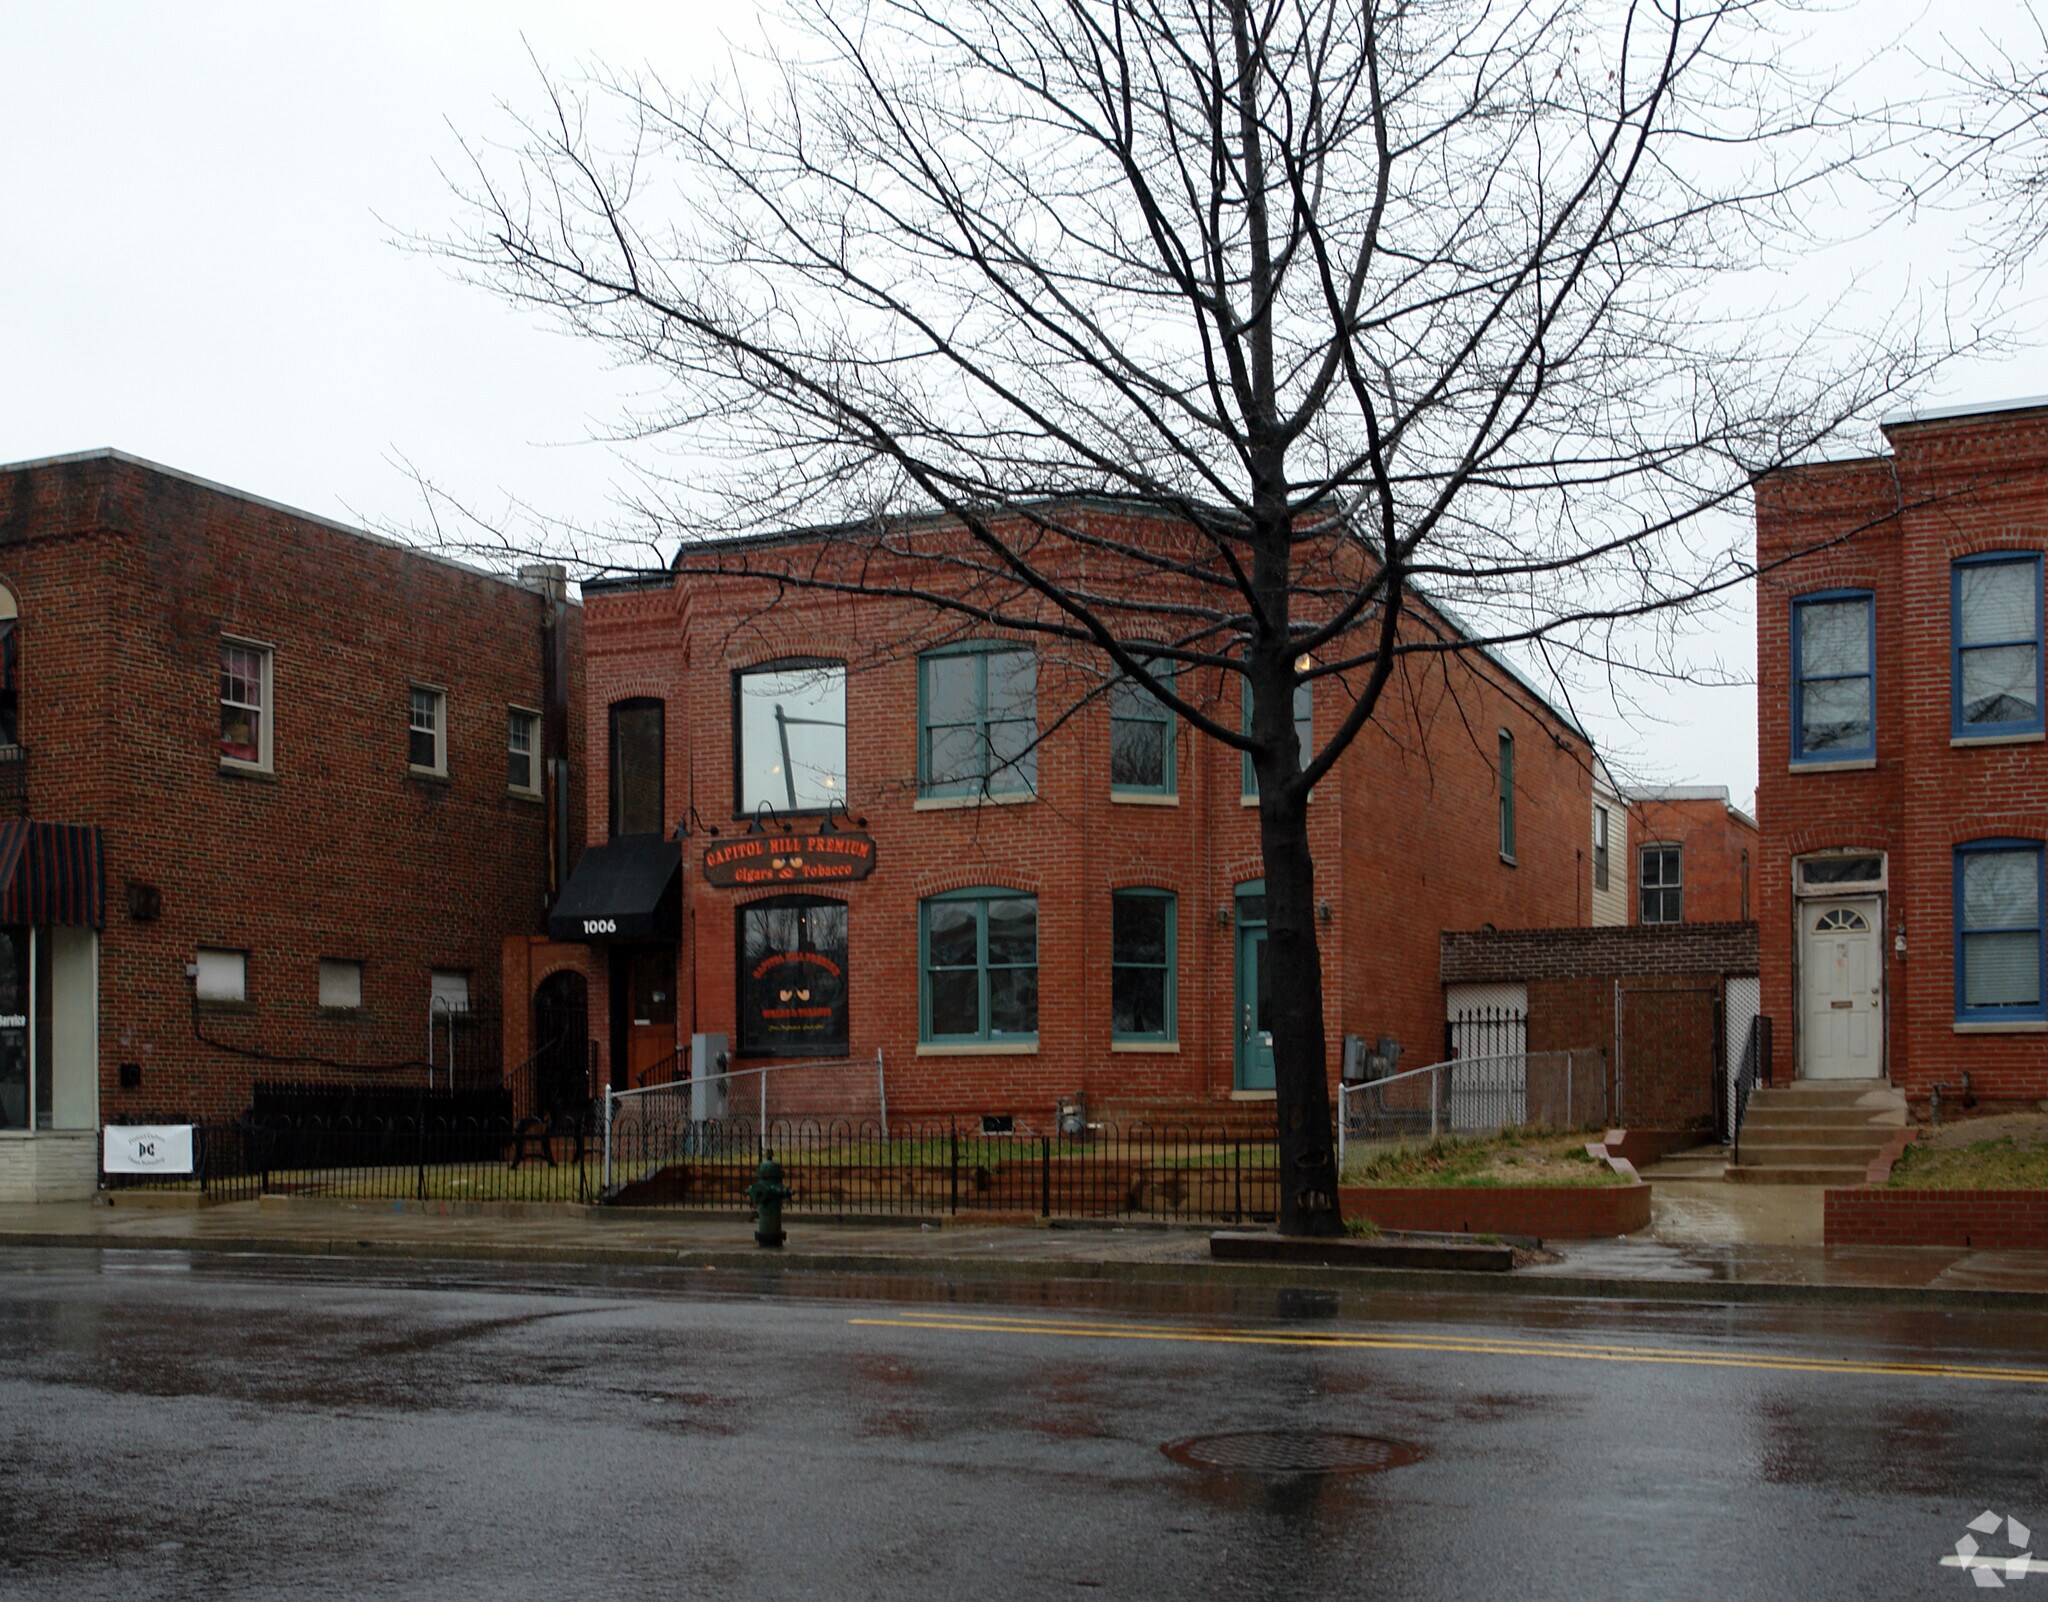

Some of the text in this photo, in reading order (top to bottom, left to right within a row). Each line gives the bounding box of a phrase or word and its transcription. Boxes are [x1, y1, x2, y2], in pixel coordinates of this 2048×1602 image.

[706, 836, 869, 867] CAPITOL HILL PREMIUM
[735, 864, 853, 883] Cigars & Tobacco
[583, 919, 616, 935] 1006
